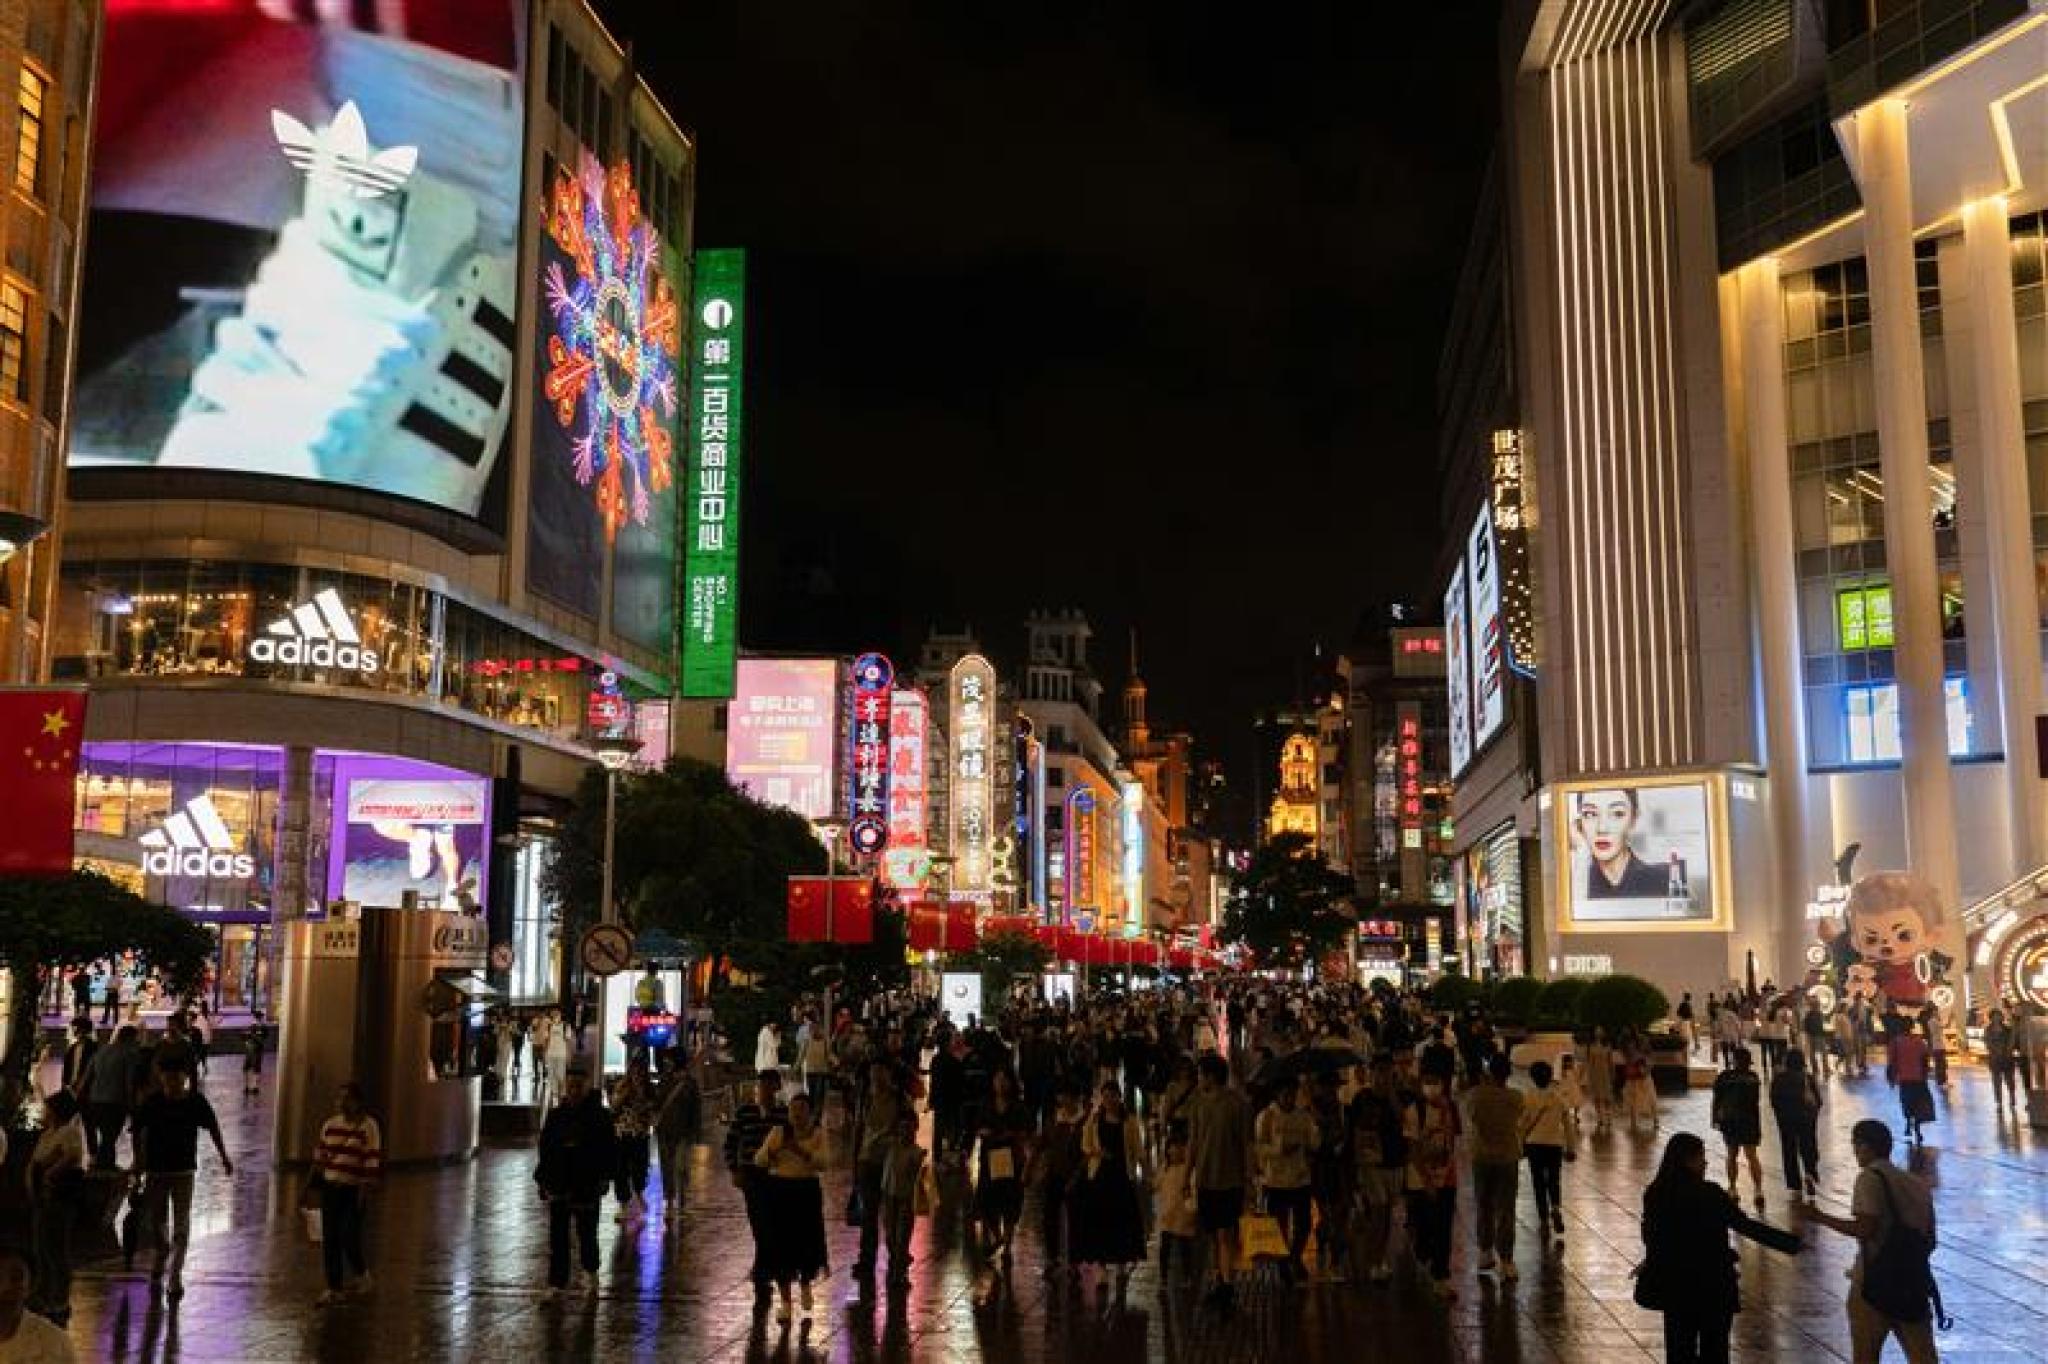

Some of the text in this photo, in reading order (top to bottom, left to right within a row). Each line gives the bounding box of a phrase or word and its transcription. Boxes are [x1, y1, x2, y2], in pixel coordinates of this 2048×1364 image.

[692, 576, 703, 628] CENTER
[704, 575, 715, 643] SHOPPING
[250, 633, 378, 673] adidas
